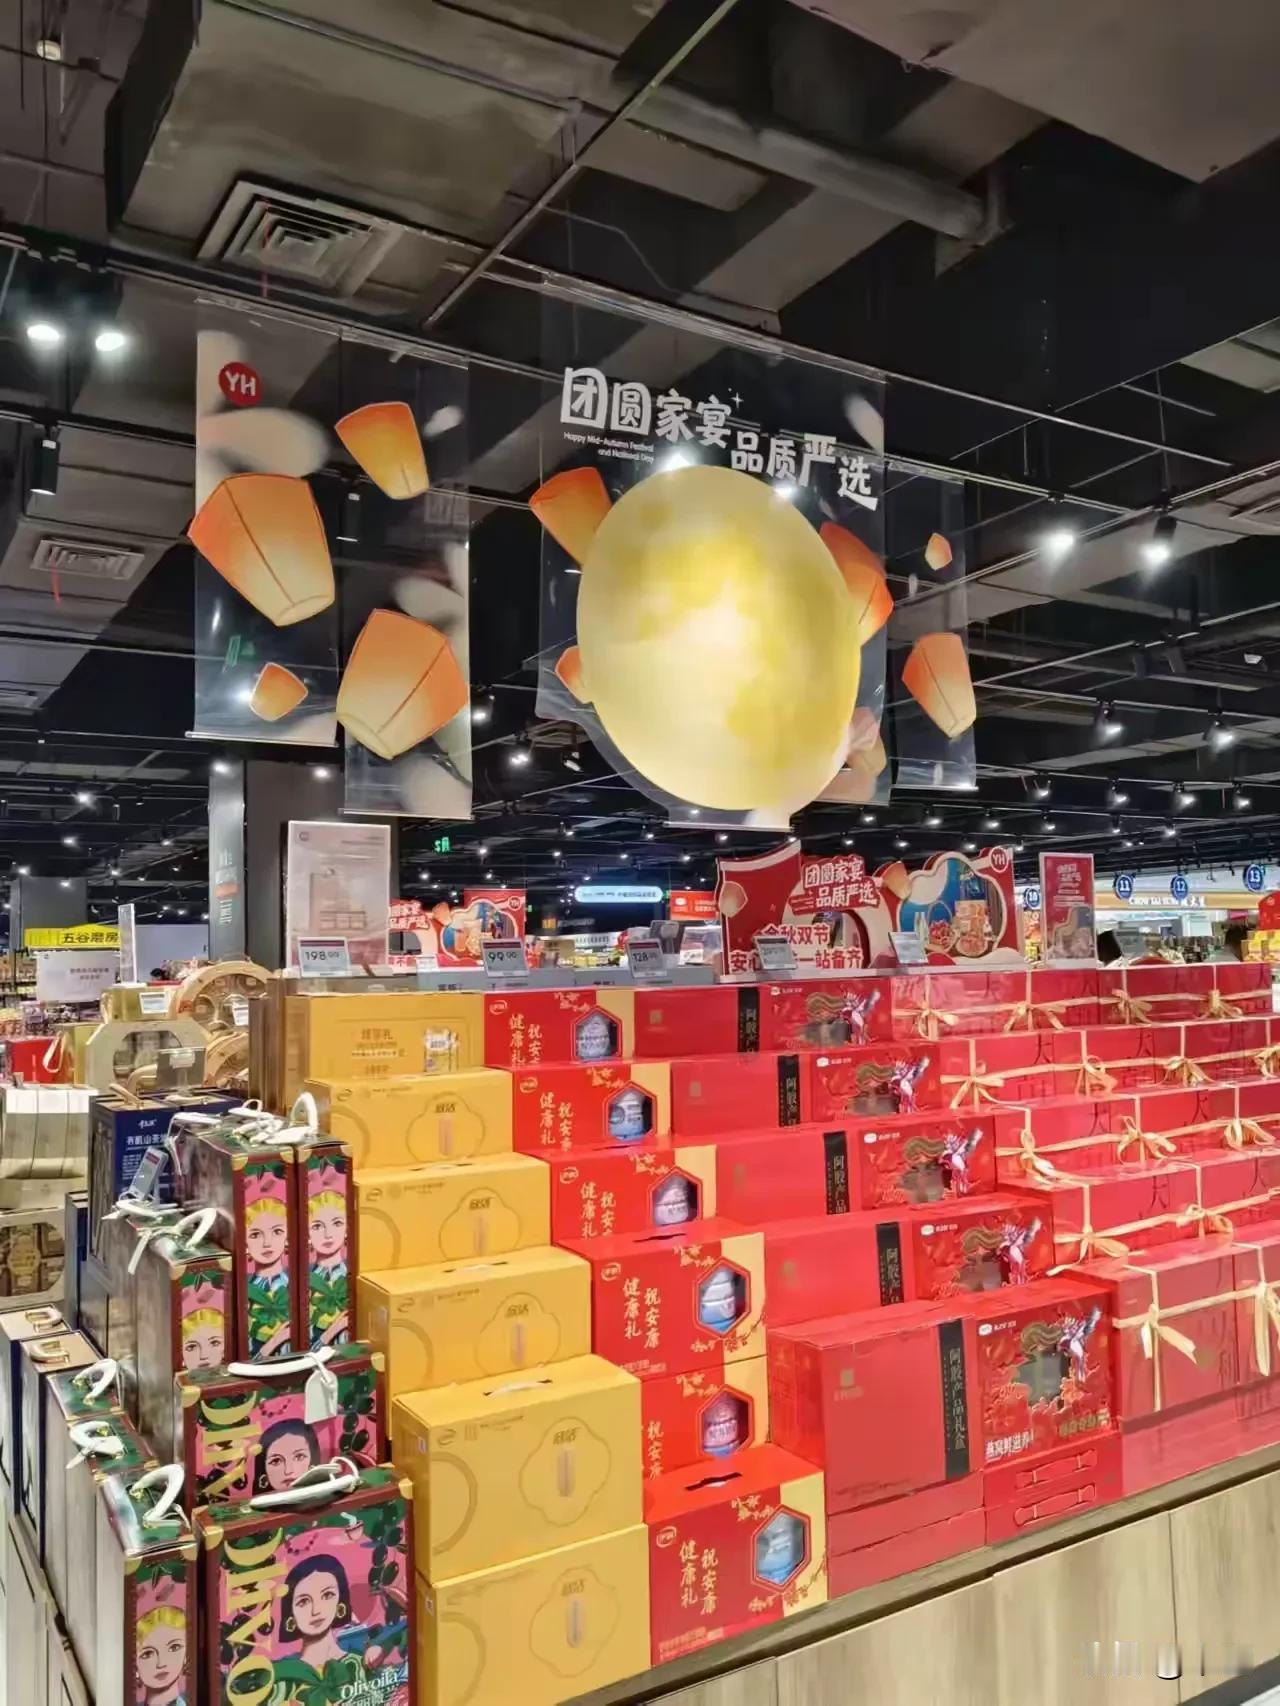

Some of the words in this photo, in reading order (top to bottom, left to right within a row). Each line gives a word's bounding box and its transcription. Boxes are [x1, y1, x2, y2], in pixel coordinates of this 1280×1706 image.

[225, 371, 256, 396] YH
[560, 367, 731, 448] 团圆家宴
[731, 431, 878, 511] 品质严选
[564, 432, 586, 444] Happy
[597, 448, 611, 457] and
[805, 858, 864, 887] 团圆家宴
[992, 853, 1006, 865] YH
[1119, 879, 1131, 892] 11
[1176, 880, 1186, 892] 12
[1249, 872, 1261, 883] 13
[816, 881, 878, 908] 品质严选
[63, 931, 120, 944] 五谷磨房
[539, 1092, 556, 1146] 健康礼
[580, 1182, 598, 1240] 健康礼
[622, 1277, 642, 1339] 健康礼
[643, 1287, 661, 1349] 祝安康
[647, 1420, 664, 1480] 祝安康
[678, 1539, 699, 1608] 健康礼
[700, 1547, 719, 1616] 祝安康
